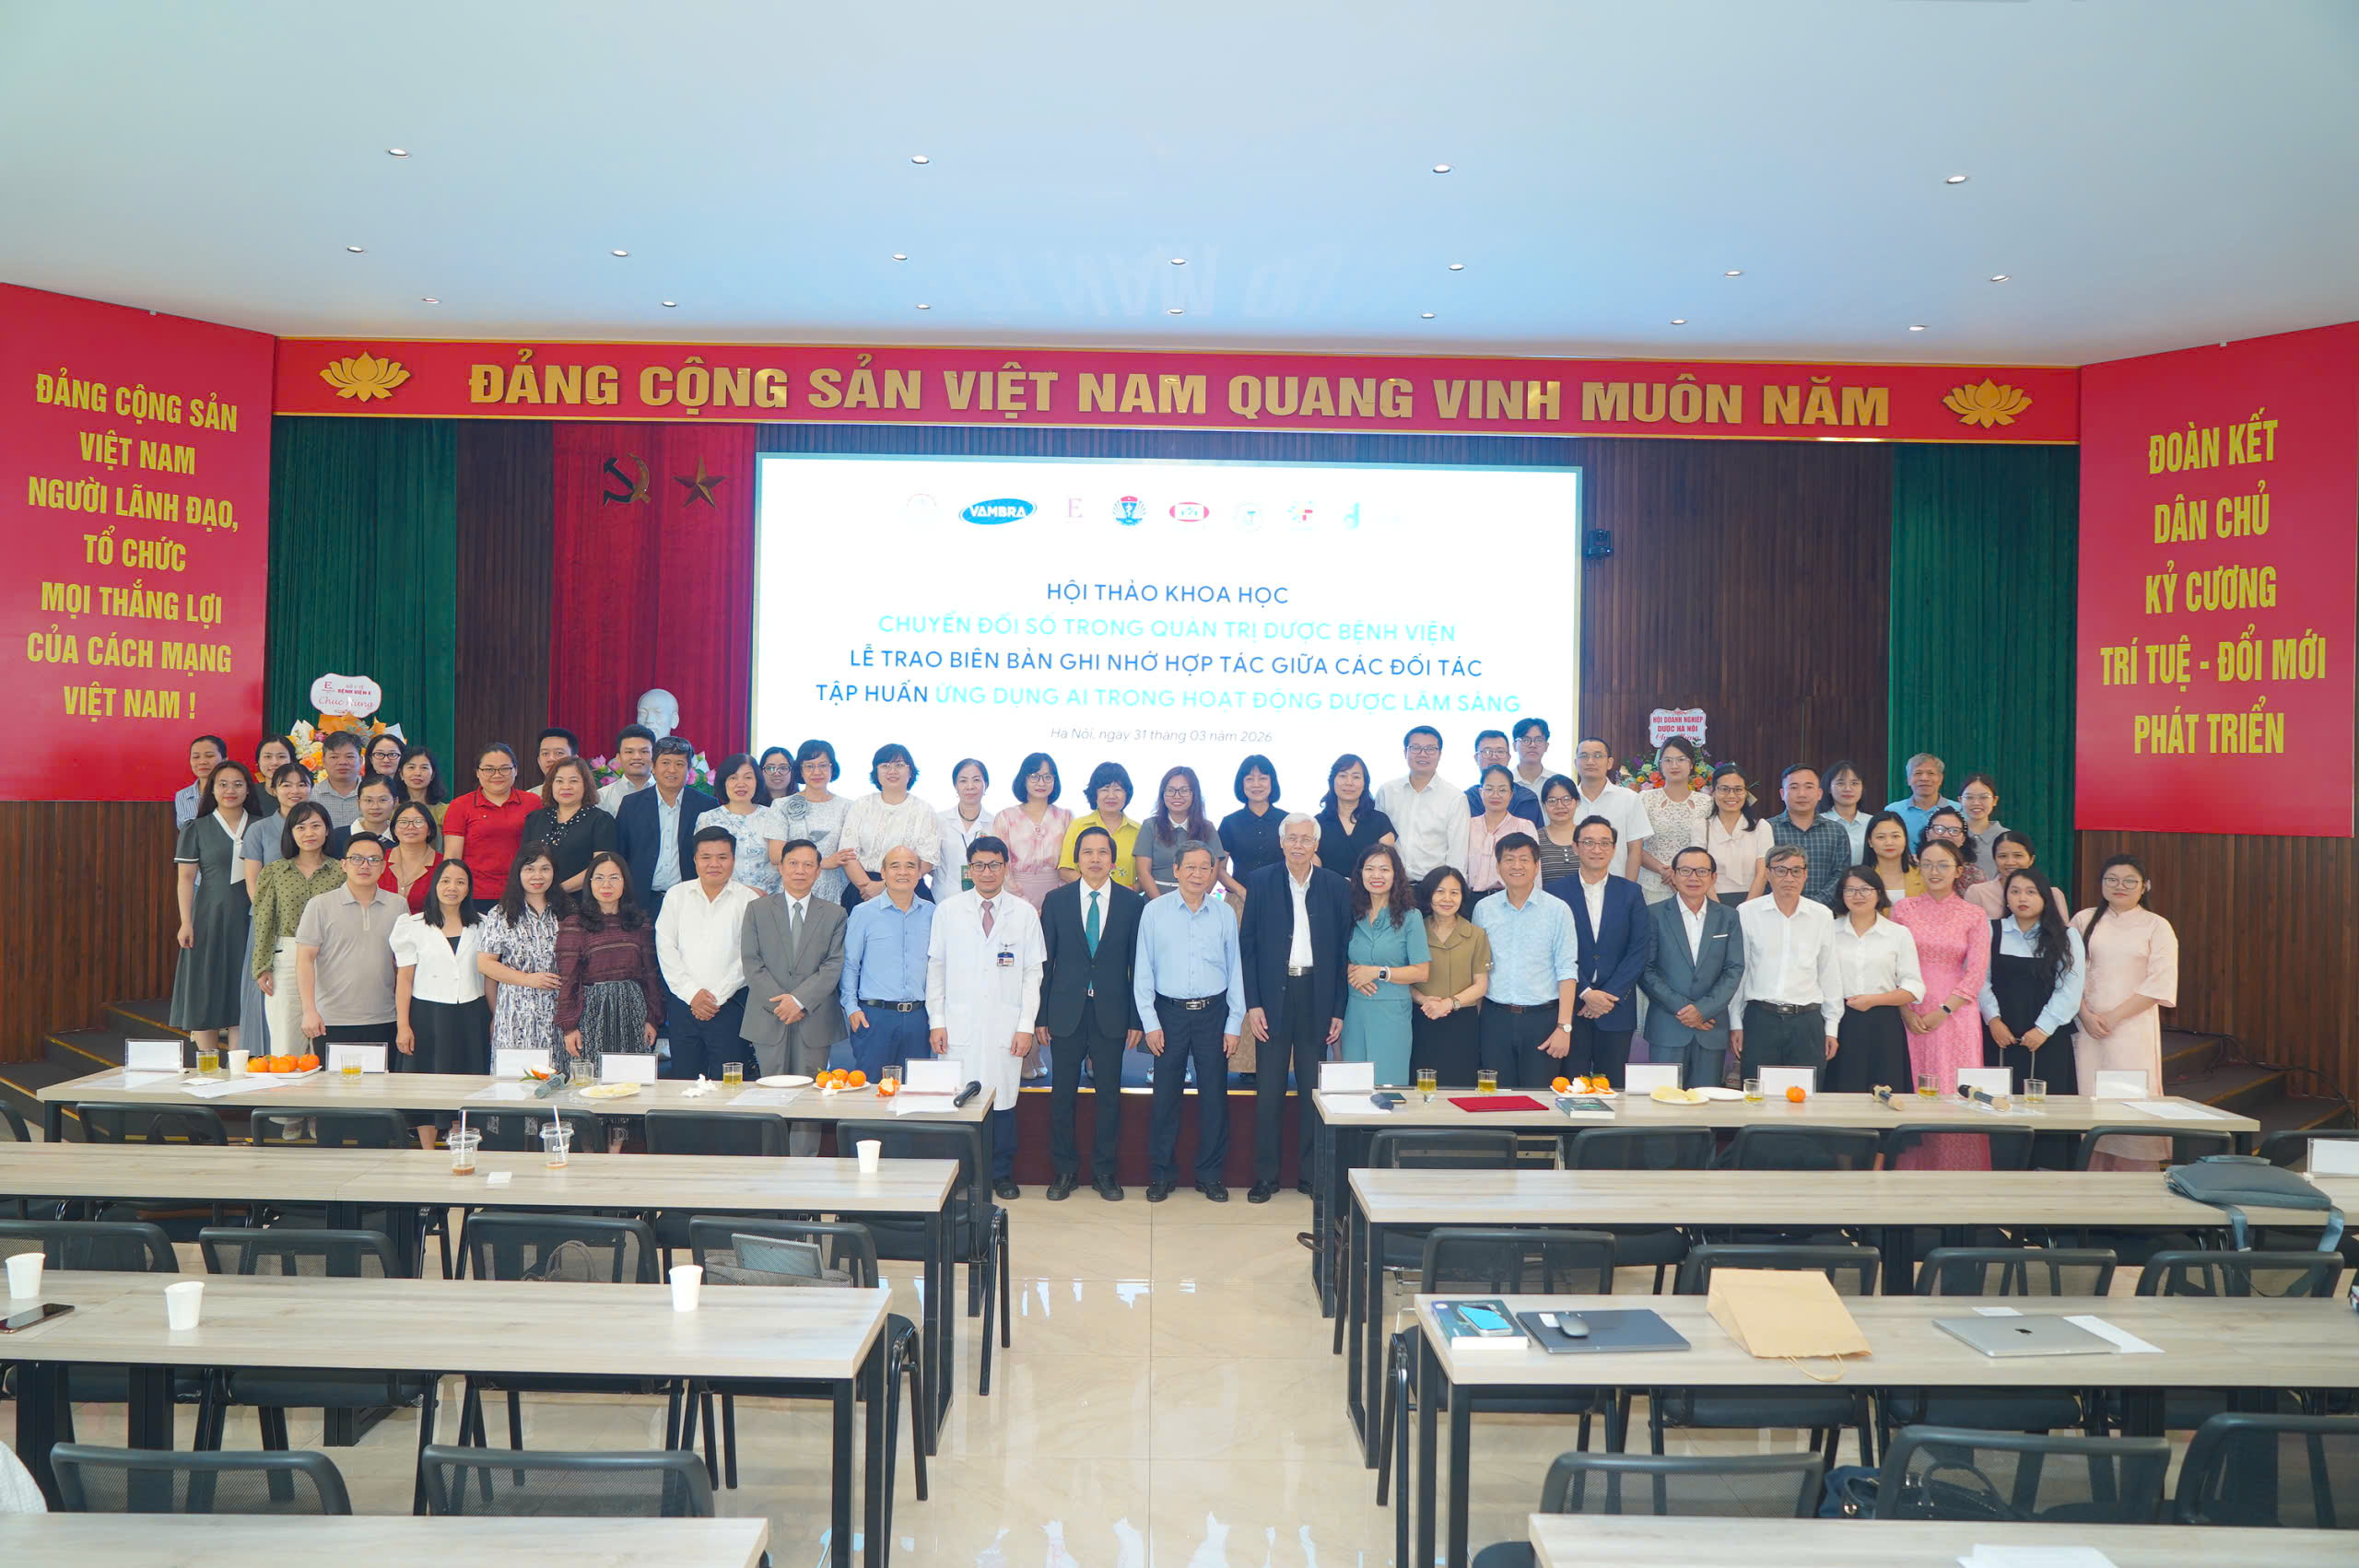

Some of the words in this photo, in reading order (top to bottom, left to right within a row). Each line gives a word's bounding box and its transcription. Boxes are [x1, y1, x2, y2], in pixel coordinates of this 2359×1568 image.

[37, 369, 106, 412] ĐẢNG
[116, 384, 181, 424] CỘNG
[190, 392, 236, 431] SẢN
[469, 348, 617, 404] ĐẢNG
[640, 357, 787, 415] CỘNG
[809, 354, 921, 409] SẢN
[944, 362, 1058, 417] VIỆT
[1079, 374, 1205, 413] NAM
[1229, 376, 1411, 418] QUANG
[1435, 380, 1560, 419] VINH
[1583, 374, 1742, 423] MUÔN
[1764, 376, 1888, 426] NĂM
[80, 430, 132, 470] VIỆT
[140, 440, 194, 474] NAM
[2149, 422, 2219, 474] ĐOÀN
[2229, 408, 2278, 464] KẾT
[29, 476, 107, 513] NGƯỜI
[116, 484, 179, 521] LÃNH
[187, 497, 238, 532] ĐẠO,
[969, 505, 1028, 518] VAMBRA
[2154, 494, 2206, 544] DÂN
[2216, 480, 2269, 538] CHỦ
[84, 525, 114, 564] TỔ
[123, 536, 186, 571] CHỨC
[41, 582, 90, 619] MỌI
[99, 579, 179, 619] THẮNG
[187, 593, 221, 628] LỢI
[1048, 579, 1087, 604] HỘI
[1094, 579, 1159, 602] THẢO
[1166, 585, 1231, 603] KHOA
[1238, 586, 1290, 608] HỌC
[2146, 560, 2177, 614] KỶ
[2187, 565, 2276, 612] CƯƠNG
[28, 624, 78, 663] CỦA
[88, 632, 153, 668] CÁCH
[162, 641, 231, 676] MẠNG
[1025, 612, 1056, 636] SỐ
[1062, 619, 1144, 637] TRONG
[1224, 619, 1257, 644] TRỊ
[1263, 619, 1332, 645] DƯỢC
[1338, 619, 1398, 645] BỆNH
[1404, 620, 1456, 647] VIỆN
[851, 643, 874, 668] LỄ
[880, 649, 944, 668] TRAO
[950, 647, 1000, 670] BIÊN
[1007, 647, 1053, 670] BẢN
[1060, 652, 1100, 671] GHI
[1106, 650, 1158, 672] NHỚ
[1165, 653, 1214, 676] HỢP
[1219, 652, 1265, 673] TÁC
[1272, 652, 1328, 674] GIỮA
[1334, 654, 1386, 676] CÁC
[1390, 652, 1430, 676] ĐỐI
[1438, 656, 1482, 677] TÁC
[2101, 638, 2138, 685] TRÍ
[2145, 635, 2190, 692] TUỆ
[2218, 624, 2262, 681] ĐỔI
[2272, 629, 2326, 680] MỚI
[65, 681, 116, 722] VIỆT
[124, 689, 180, 719] NAM
[189, 693, 195, 719] !
[816, 680, 859, 706] TẬP
[863, 679, 928, 703] HUẤN
[936, 682, 986, 704] ỨNG
[992, 687, 1060, 708] DỤNG
[1066, 688, 1088, 706] AI
[1094, 688, 1176, 707] TRONG
[1182, 690, 1247, 713] HOẠT
[1252, 688, 1322, 713] ĐỘNG
[1403, 690, 1452, 712] LÂM
[1684, 715, 1703, 723] NGHIỆP
[1190, 730, 1206, 742] 03
[1240, 731, 1273, 743] 2026
[2135, 707, 2199, 754] PHÁT
[2207, 696, 2284, 753] TRIỂN
